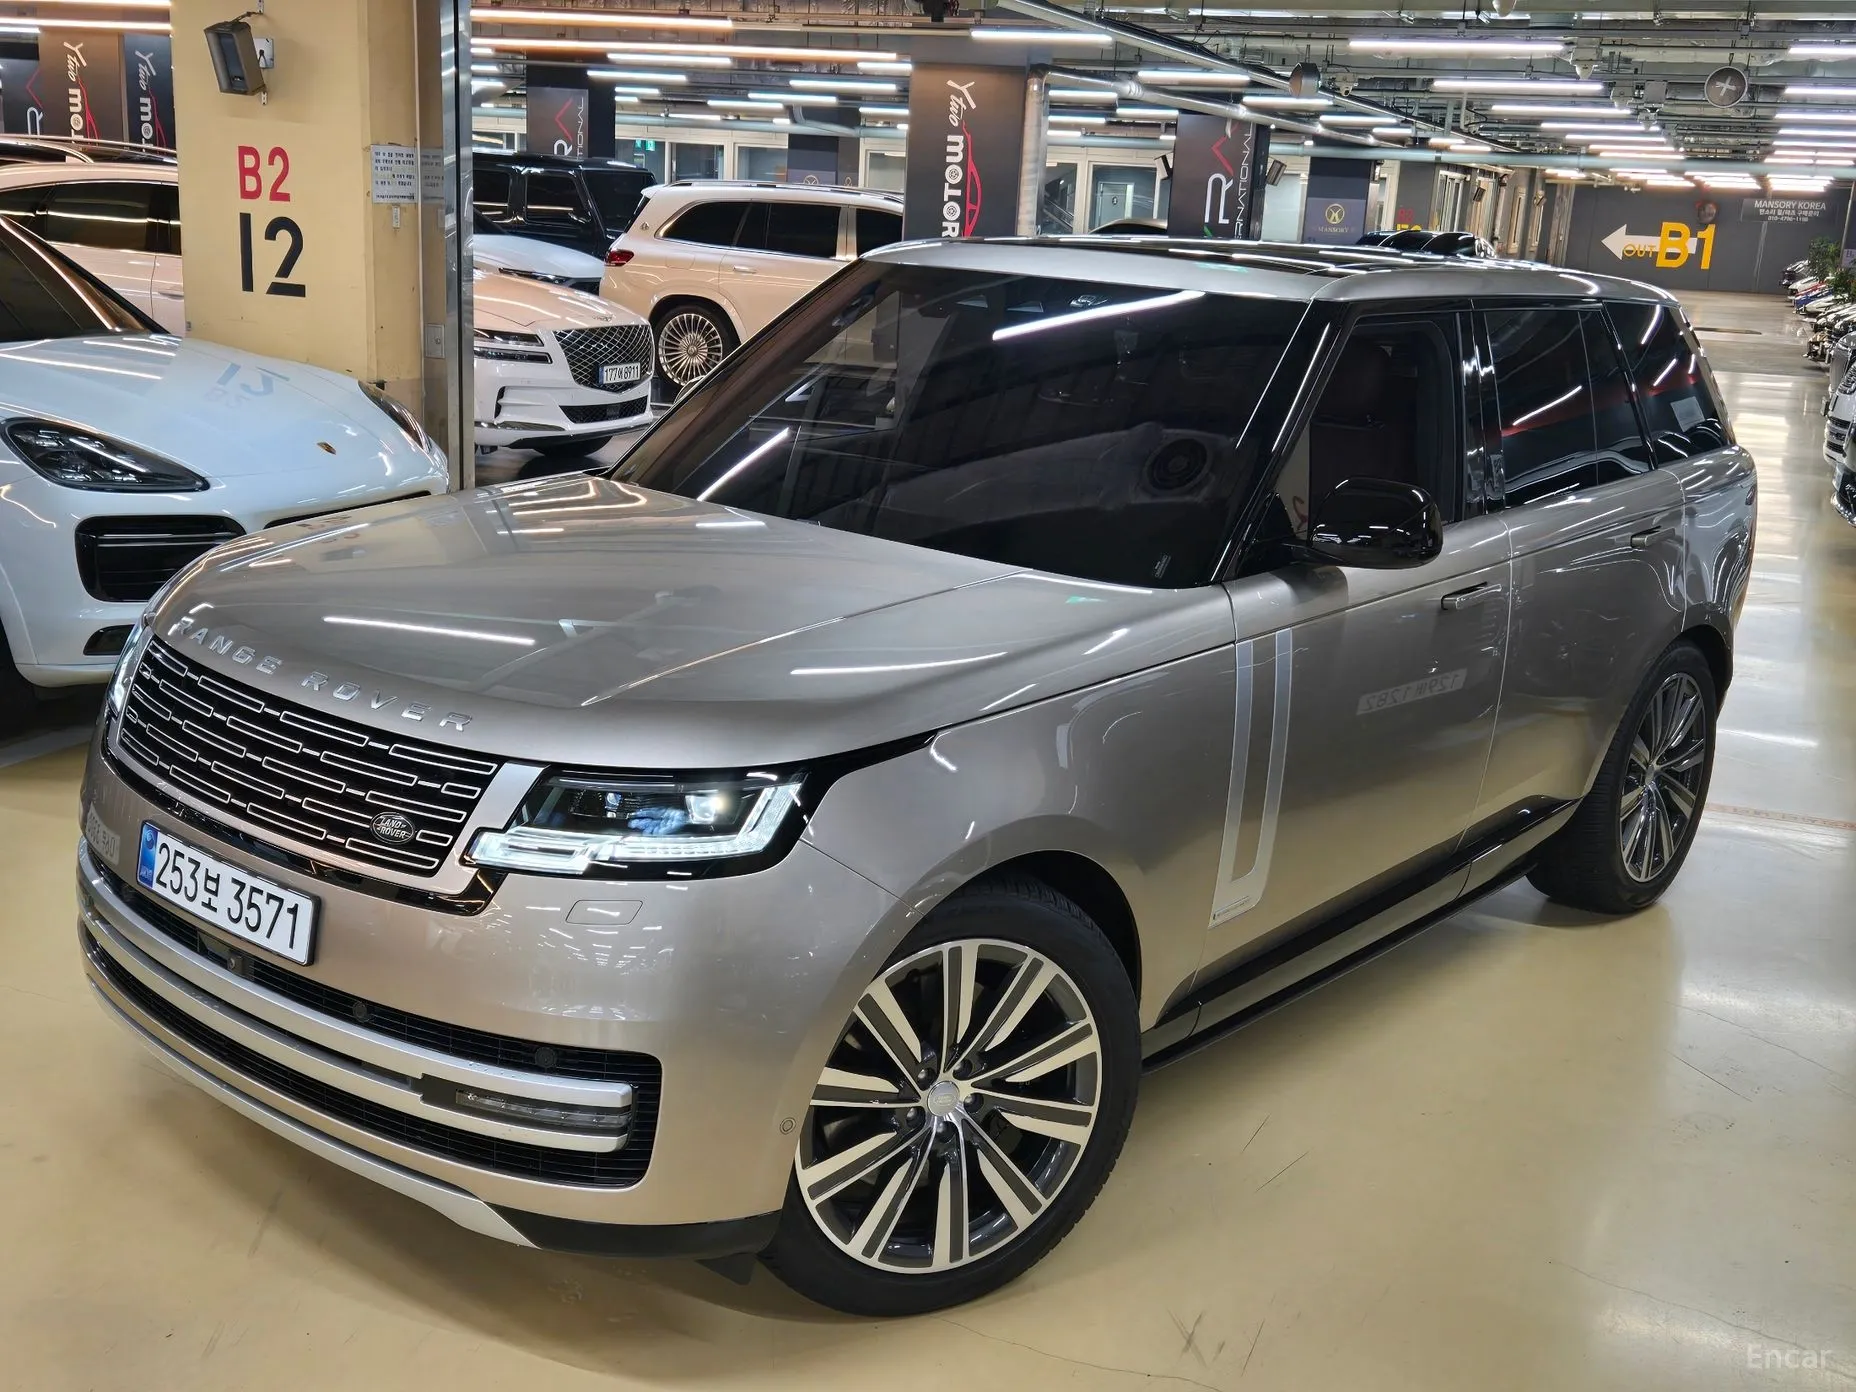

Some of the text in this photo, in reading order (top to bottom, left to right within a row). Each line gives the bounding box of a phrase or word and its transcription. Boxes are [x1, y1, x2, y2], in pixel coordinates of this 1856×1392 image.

[238, 146, 291, 202] B2
[1754, 199, 1826, 211] MANSORY KOREA
[1623, 221, 1716, 270] OUT B1
[174, 616, 473, 732] RANGE ROVER
[379, 816, 402, 829] LAND
[380, 827, 406, 839] ROVER
[155, 842, 299, 950] 253보 3571
